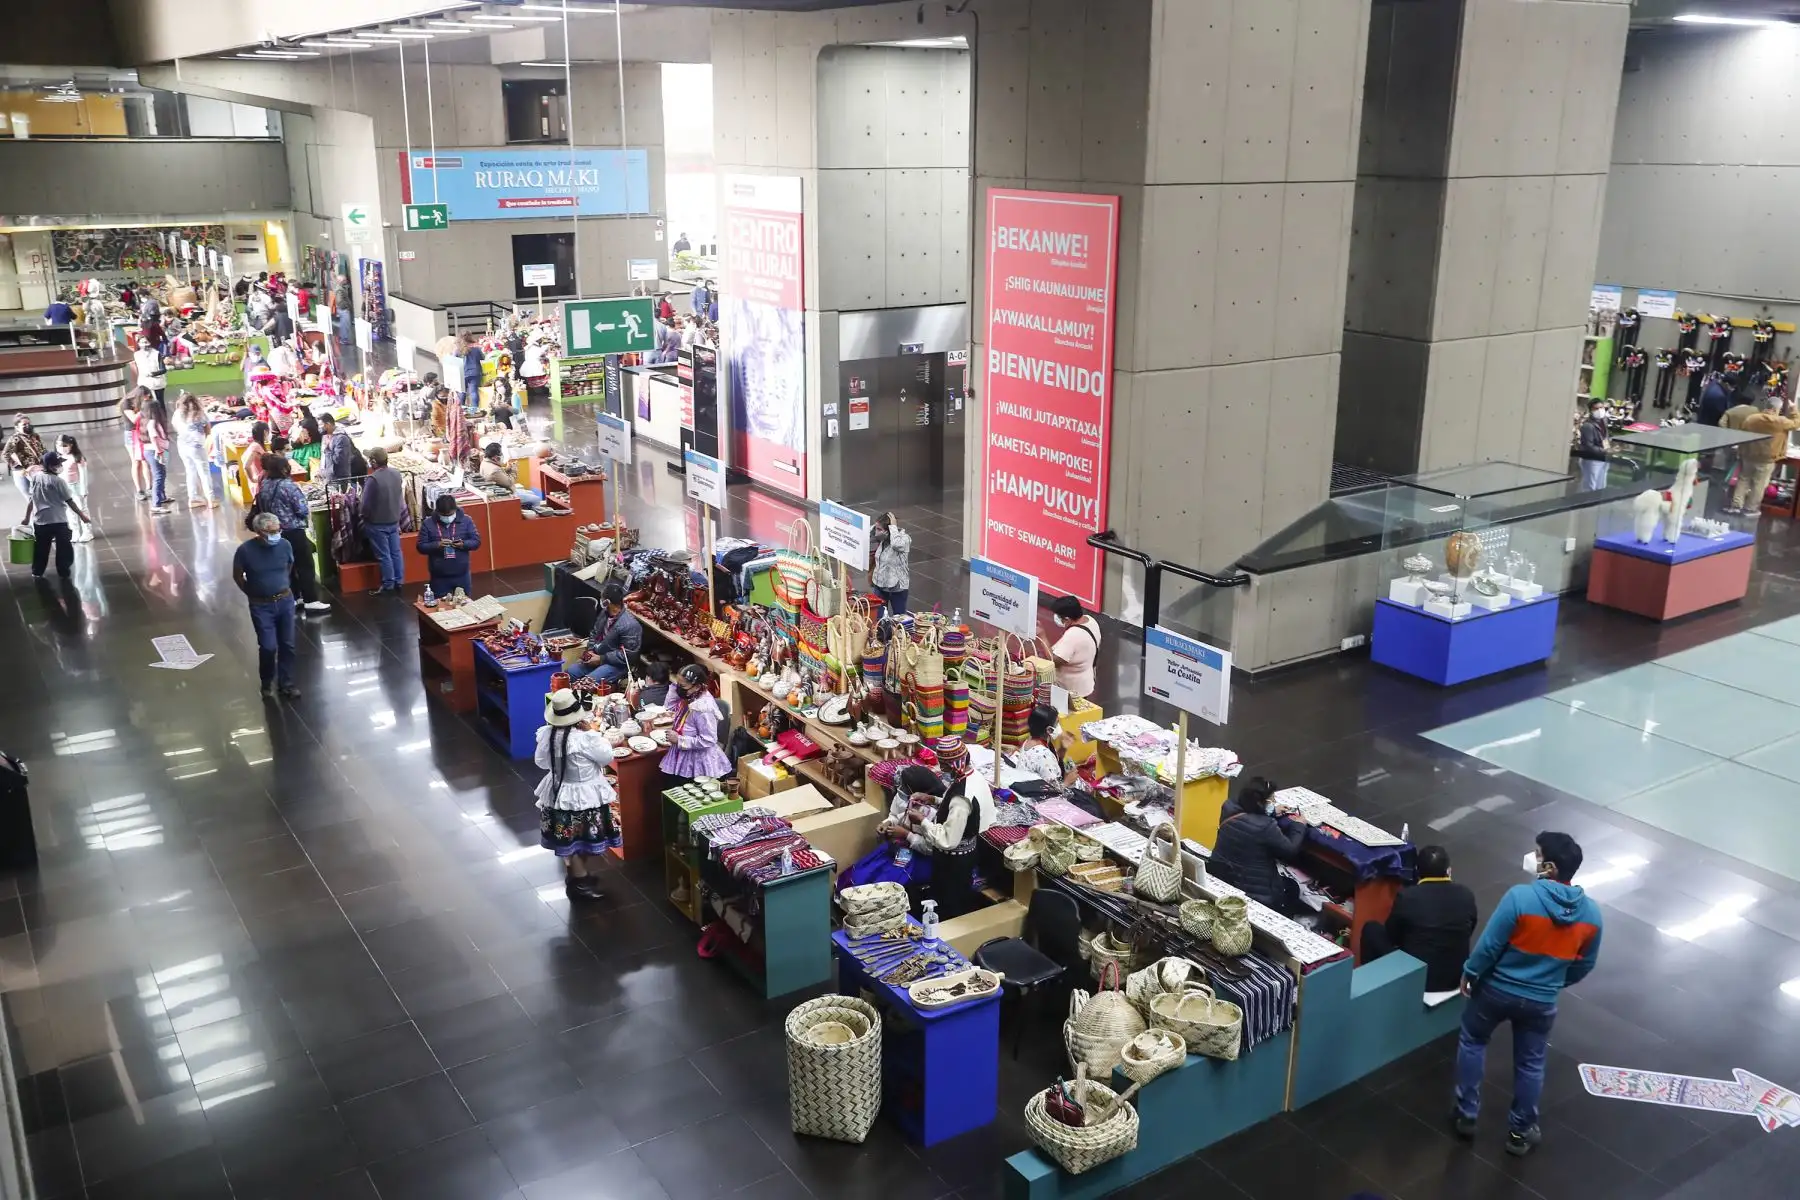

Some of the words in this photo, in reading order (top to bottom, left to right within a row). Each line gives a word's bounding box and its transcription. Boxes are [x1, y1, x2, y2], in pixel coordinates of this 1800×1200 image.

[475, 169, 543, 188] RURAQ
[547, 168, 599, 186] MAKI
[731, 217, 797, 255] CENTRO
[990, 349, 1104, 397] BIENVENIDO
[996, 400, 1032, 421] ¡WALIKI
[1039, 446, 1093, 474] PIMPOKE!
[990, 469, 1099, 523] ¡HAMPUKUY!
[1017, 529, 1053, 554] SEWAPA
[1054, 544, 1077, 560] ARR!
[982, 588, 1013, 606] Comunidad
[1167, 665, 1177, 675] La
[1177, 669, 1201, 685] Cestita
